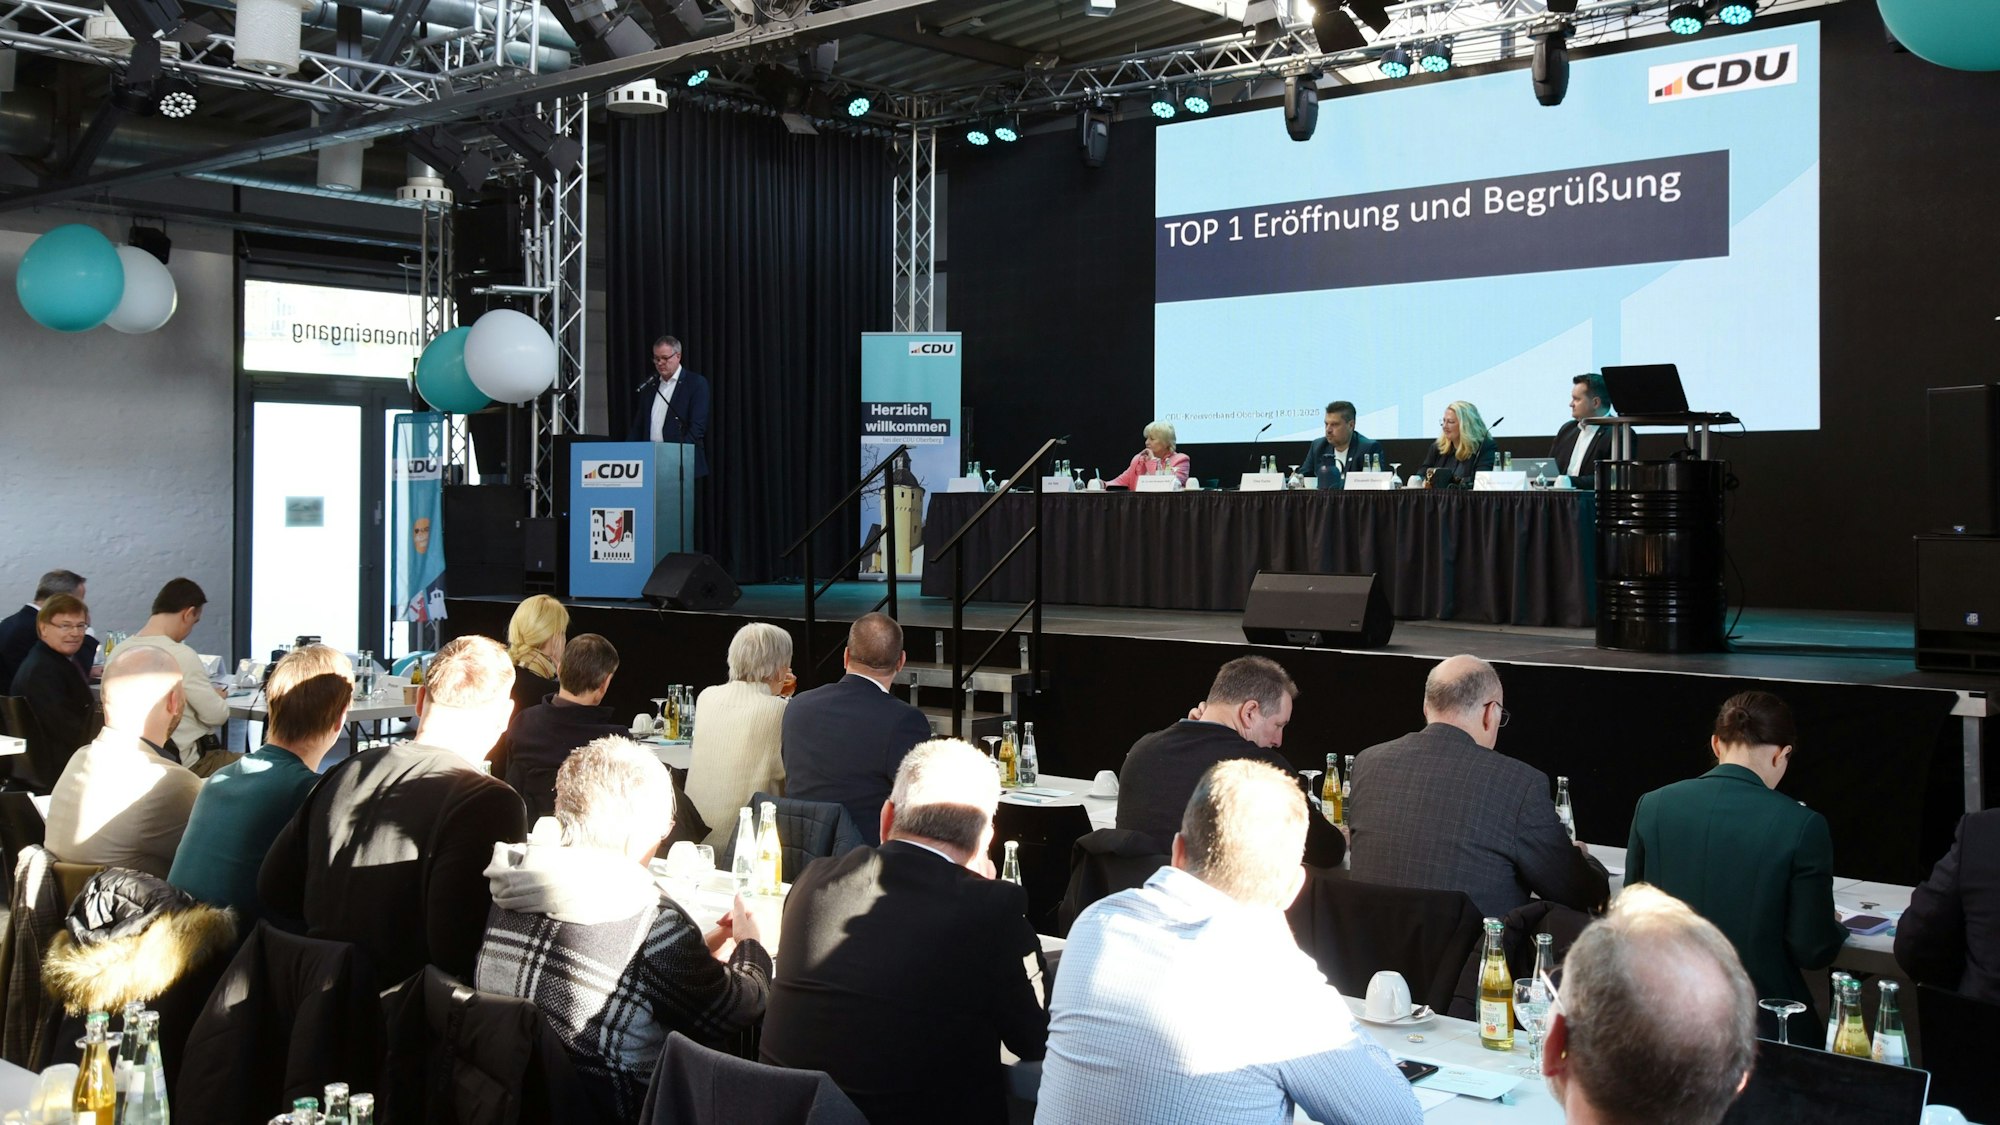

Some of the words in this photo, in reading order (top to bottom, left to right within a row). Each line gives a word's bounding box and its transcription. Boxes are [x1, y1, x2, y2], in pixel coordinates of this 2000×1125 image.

[1687, 51, 1790, 91] CDU
[1164, 218, 1219, 247] TOP
[1228, 215, 1243, 241] 1
[1254, 203, 1400, 239] Eröffnung
[1410, 187, 1471, 222] und
[1484, 171, 1681, 217] Begrüßung
[921, 343, 953, 354] CDU
[871, 403, 928, 416] Herzlich
[865, 420, 947, 433] willkommen
[598, 463, 640, 479] CDU
